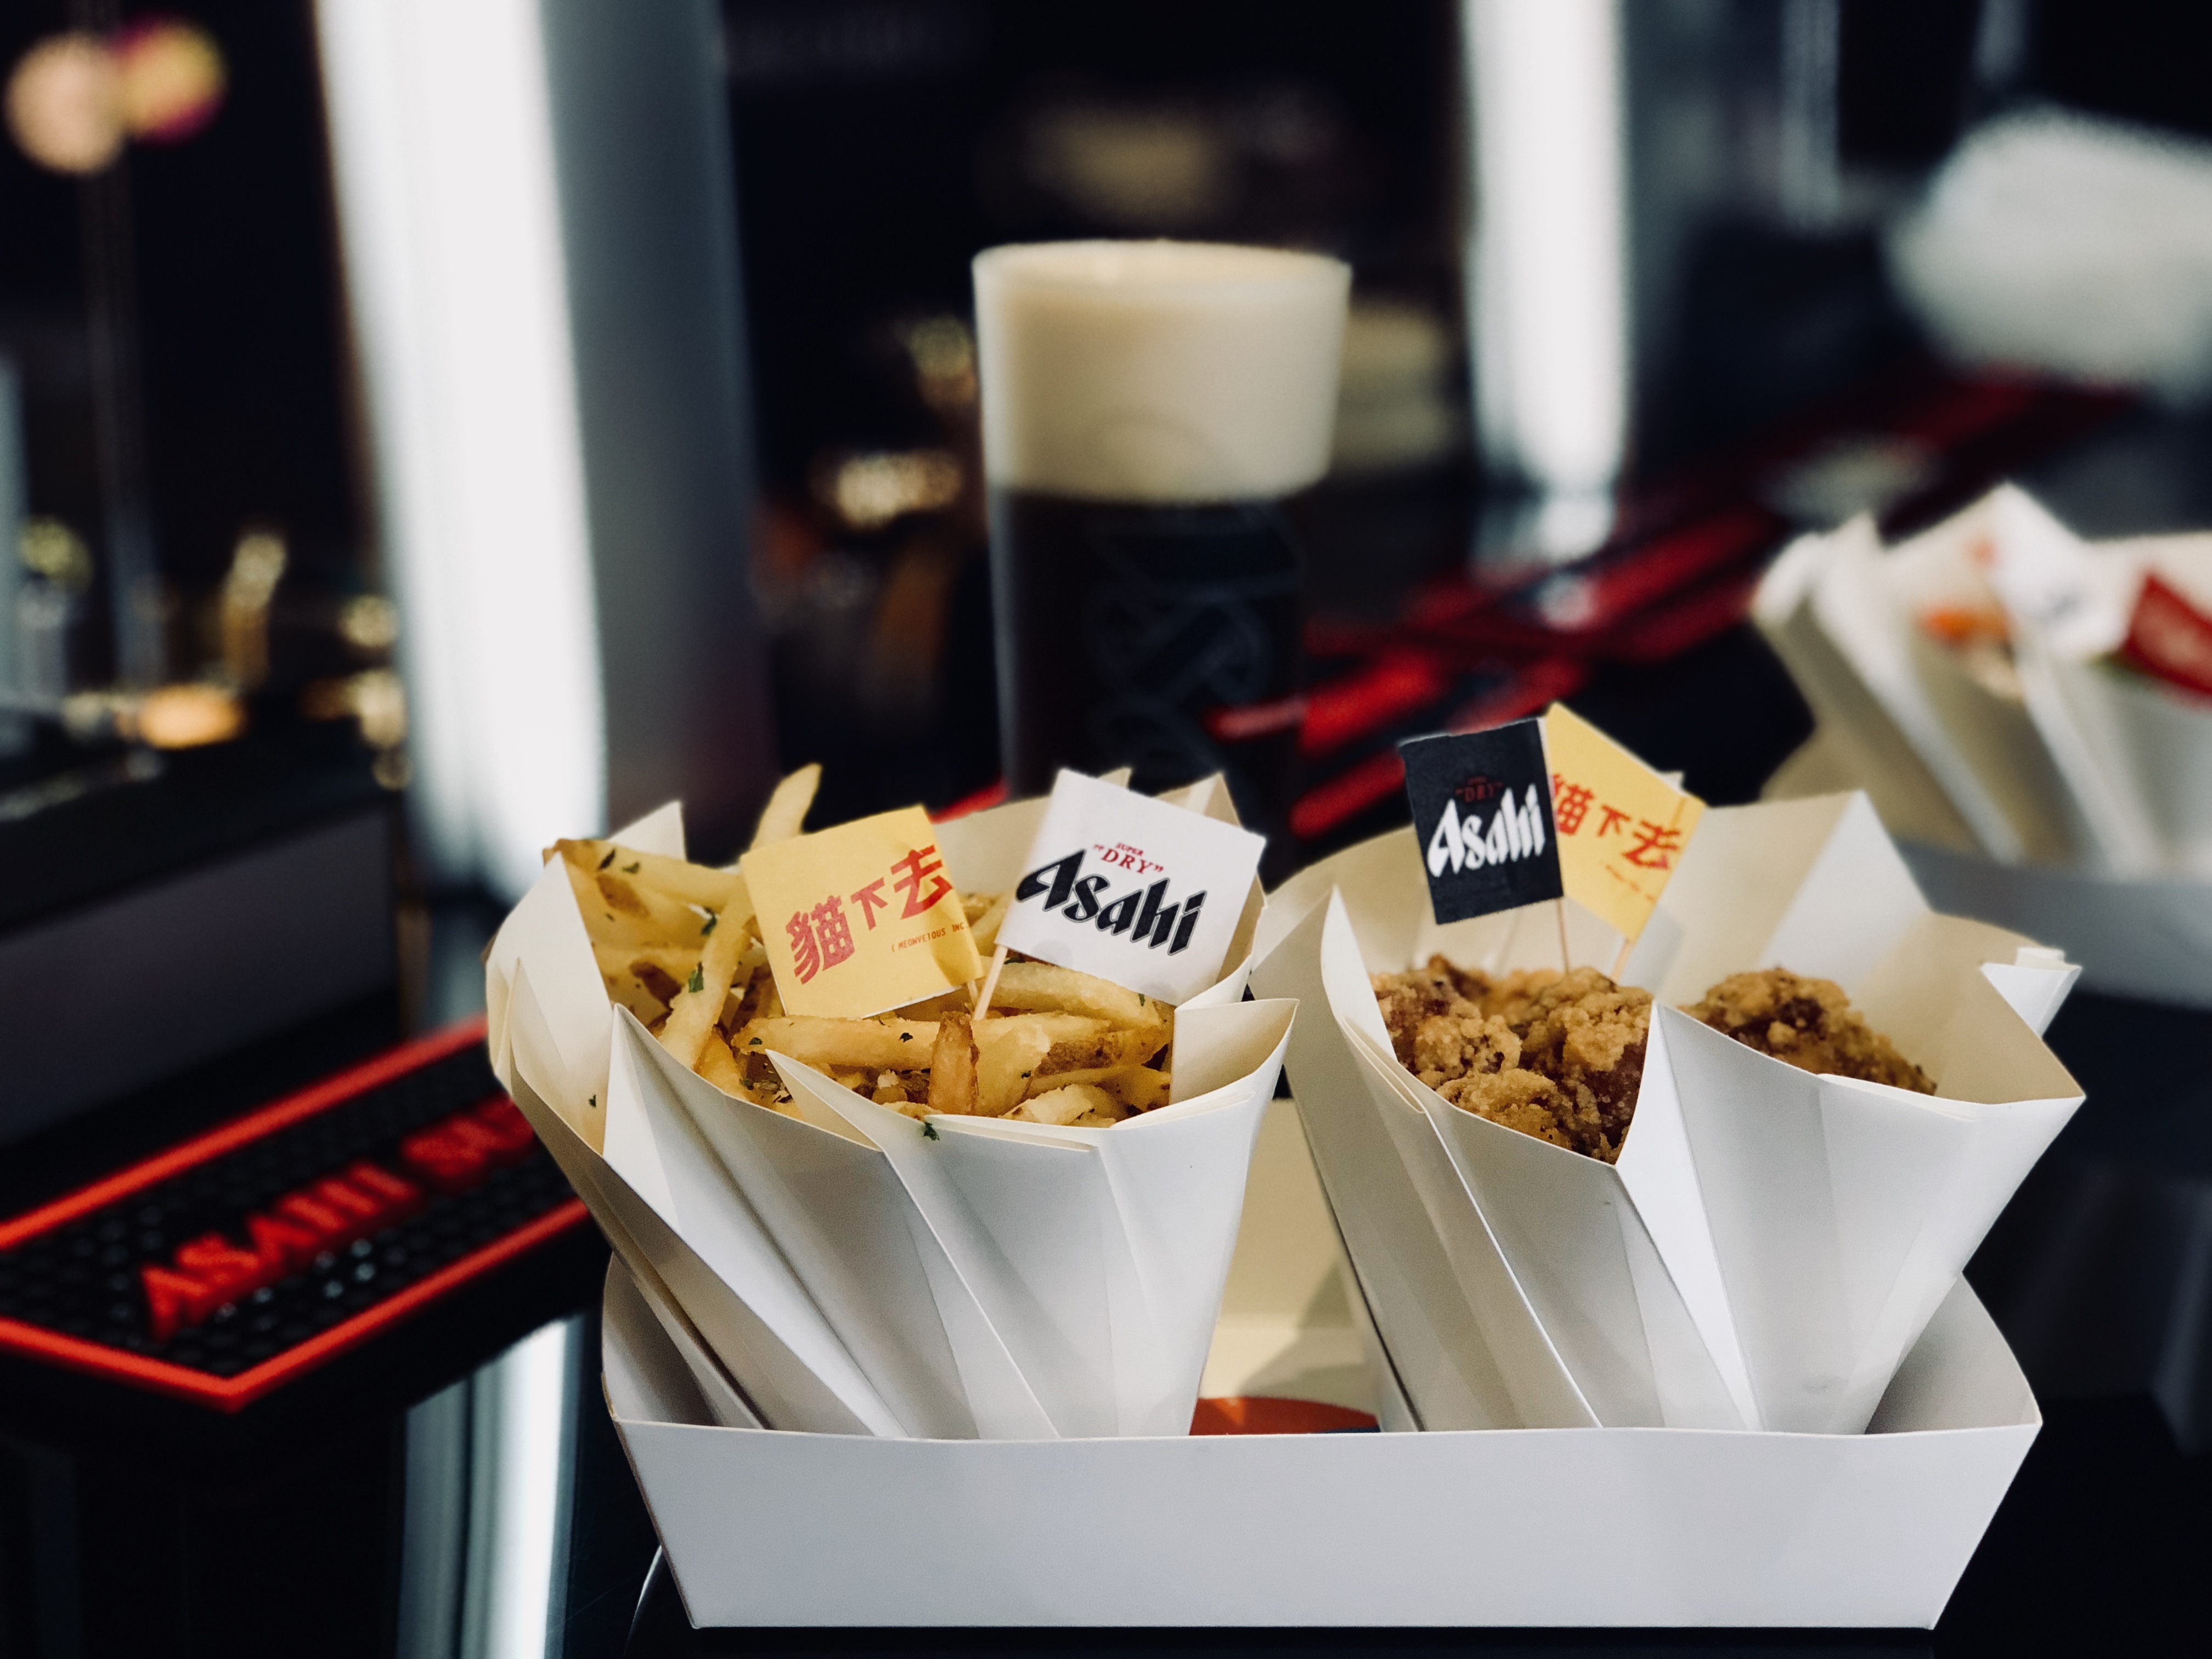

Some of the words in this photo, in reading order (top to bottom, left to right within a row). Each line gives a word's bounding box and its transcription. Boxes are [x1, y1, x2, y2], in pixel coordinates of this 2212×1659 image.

[1116, 843, 1144, 856] SUPER
[1427, 783, 1546, 878] Asahi
[786, 844, 953, 985] 貓下去
[1016, 849, 1207, 956] Asahi
[138, 1160, 421, 1341] ASAHI
